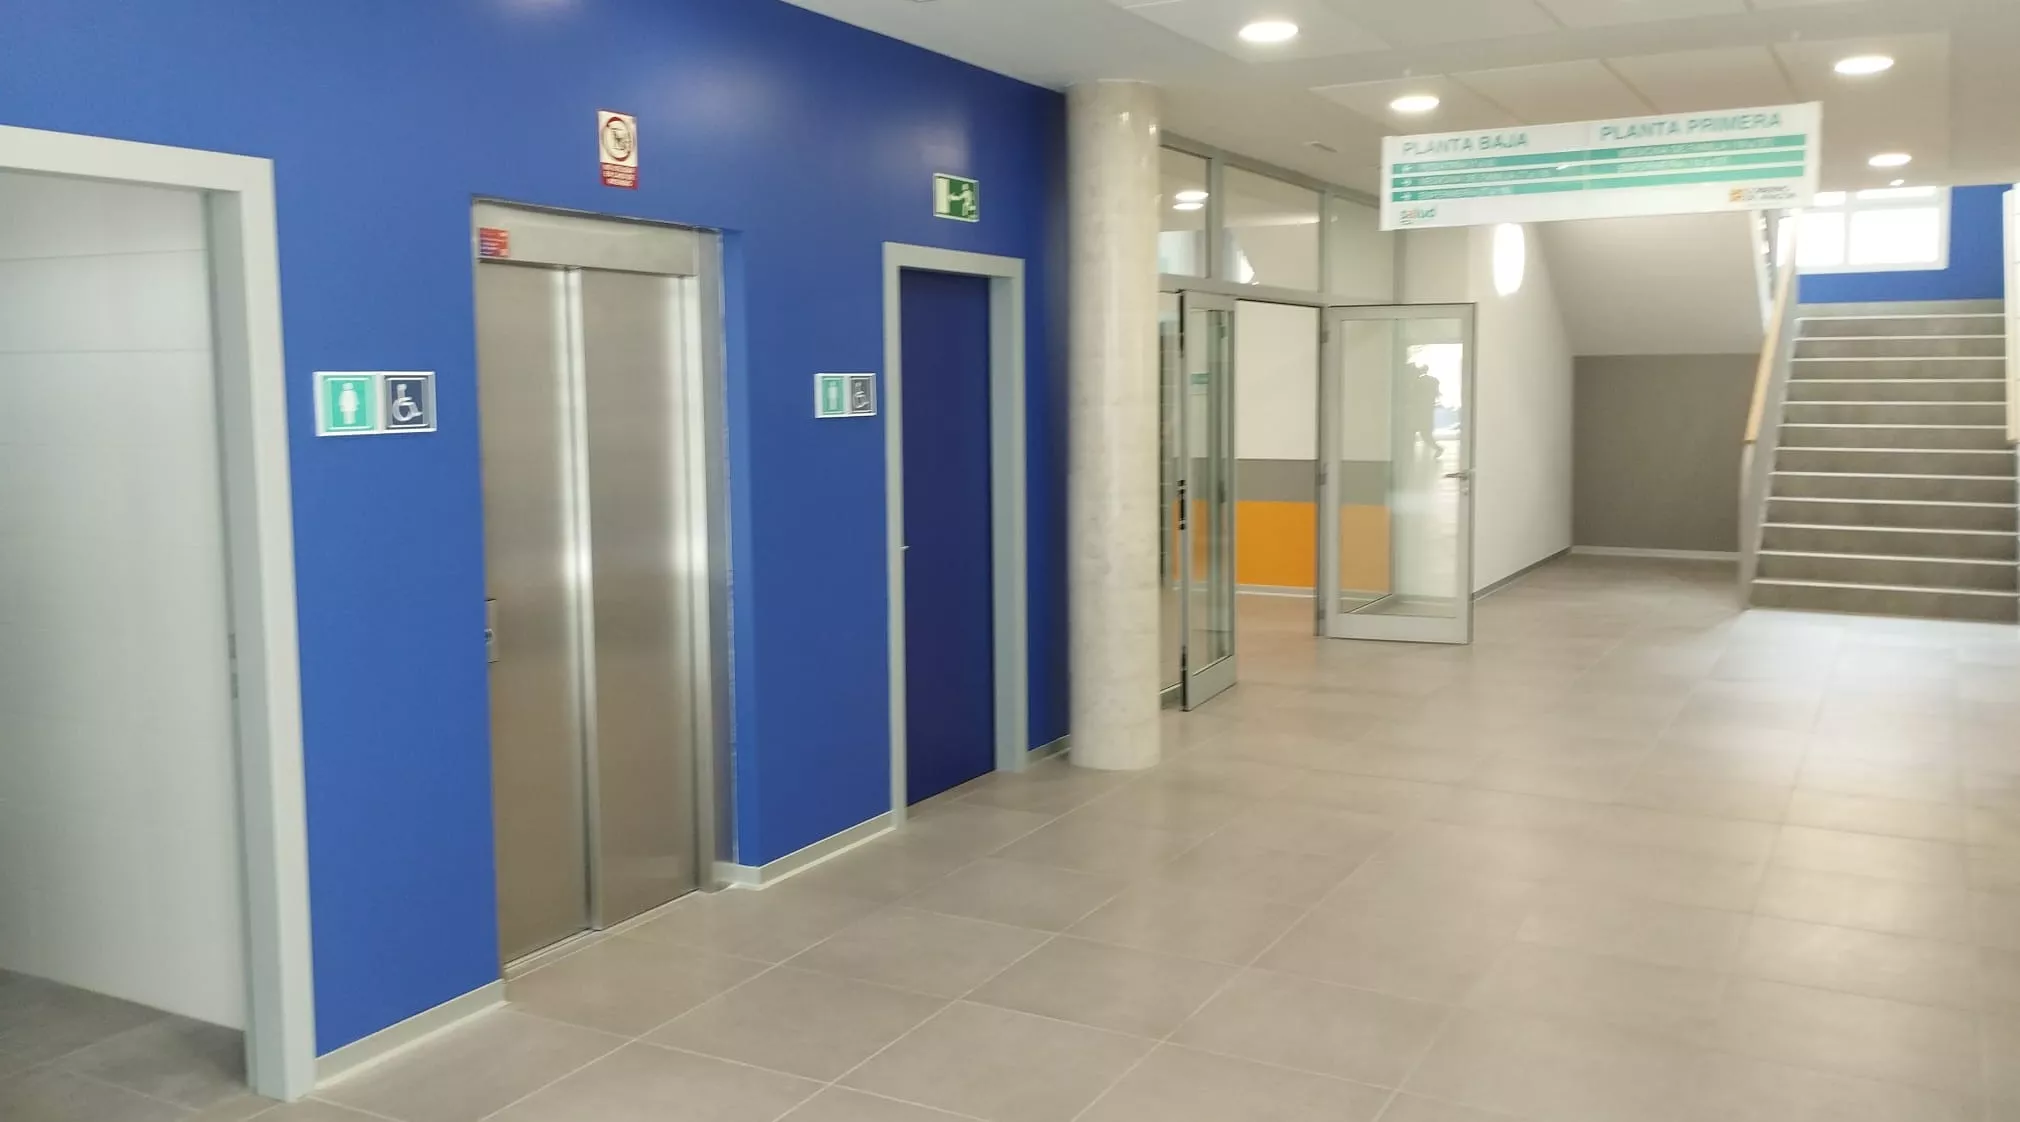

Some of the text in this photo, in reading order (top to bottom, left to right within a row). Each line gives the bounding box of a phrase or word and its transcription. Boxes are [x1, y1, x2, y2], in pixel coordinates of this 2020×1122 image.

[1601, 112, 1782, 141] PLANTA PRIMERA
[1402, 132, 1529, 156] PLANTA BAJA
